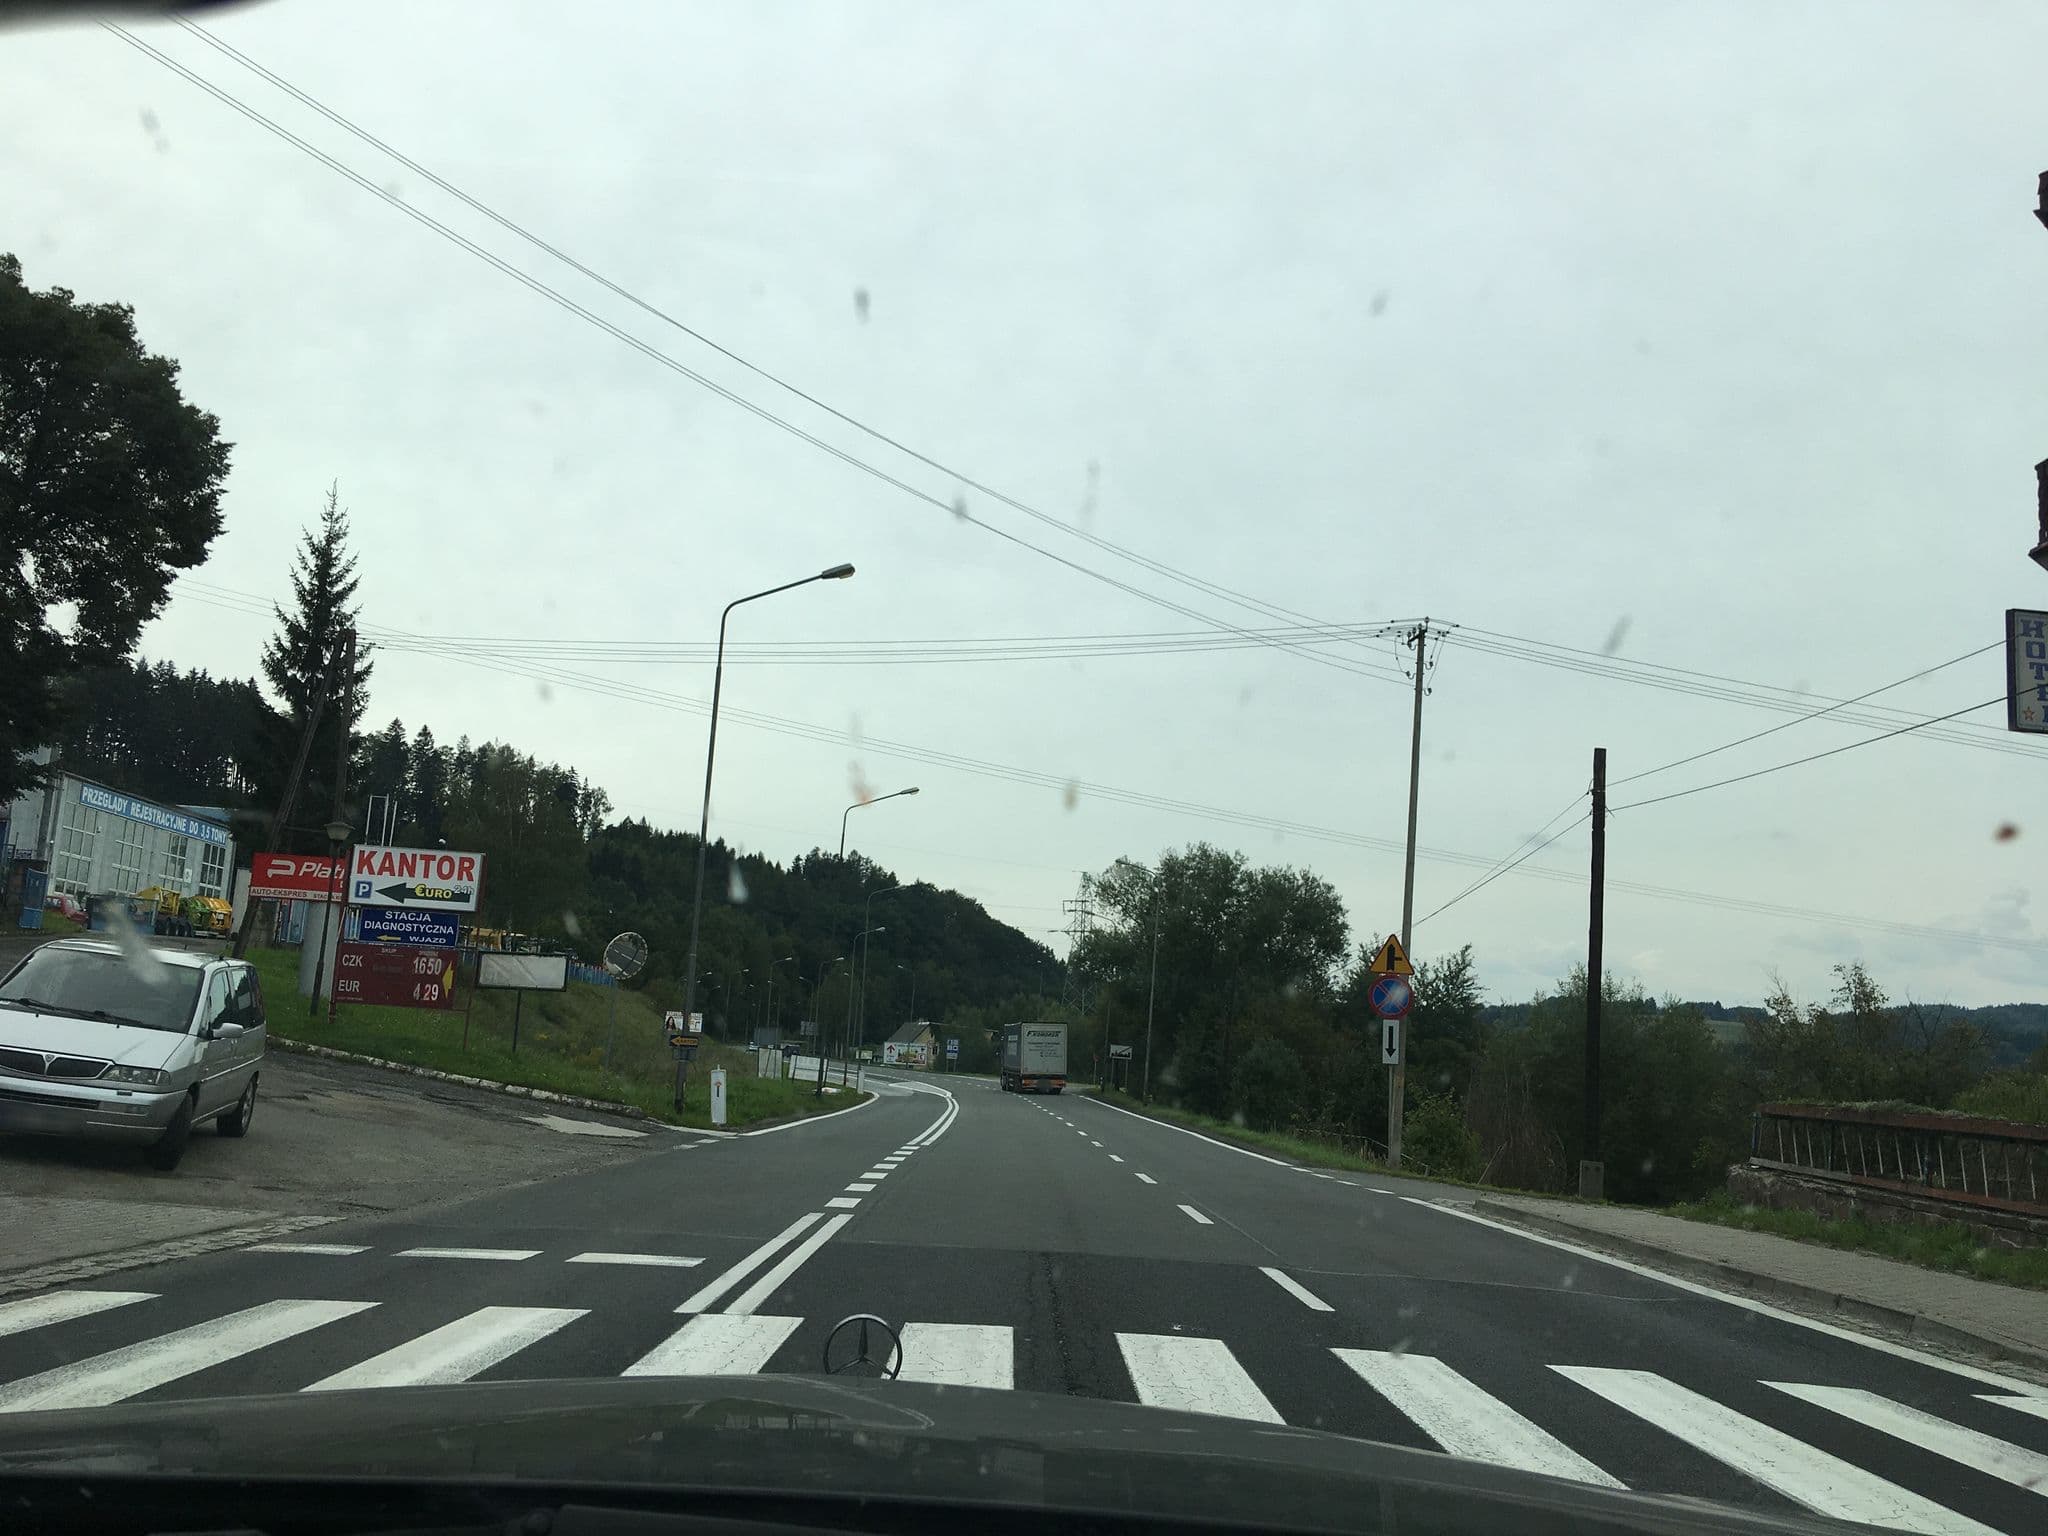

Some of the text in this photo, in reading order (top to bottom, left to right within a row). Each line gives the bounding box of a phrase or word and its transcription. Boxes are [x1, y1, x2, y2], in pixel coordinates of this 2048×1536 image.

[130, 803, 187, 832] REJESTRACYJNE
[189, 820, 199, 834] DO
[211, 828, 227, 844] TONY
[357, 850, 476, 881] KANTOR
[252, 888, 307, 898] AUTO-EKSPRES
[385, 911, 431, 922] STACJA
[364, 920, 454, 934] DIAGNOSTYCZNA
[409, 936, 447, 944] WJAZD
[342, 955, 442, 975] CZK 1650
[338, 980, 360, 992] EUR
